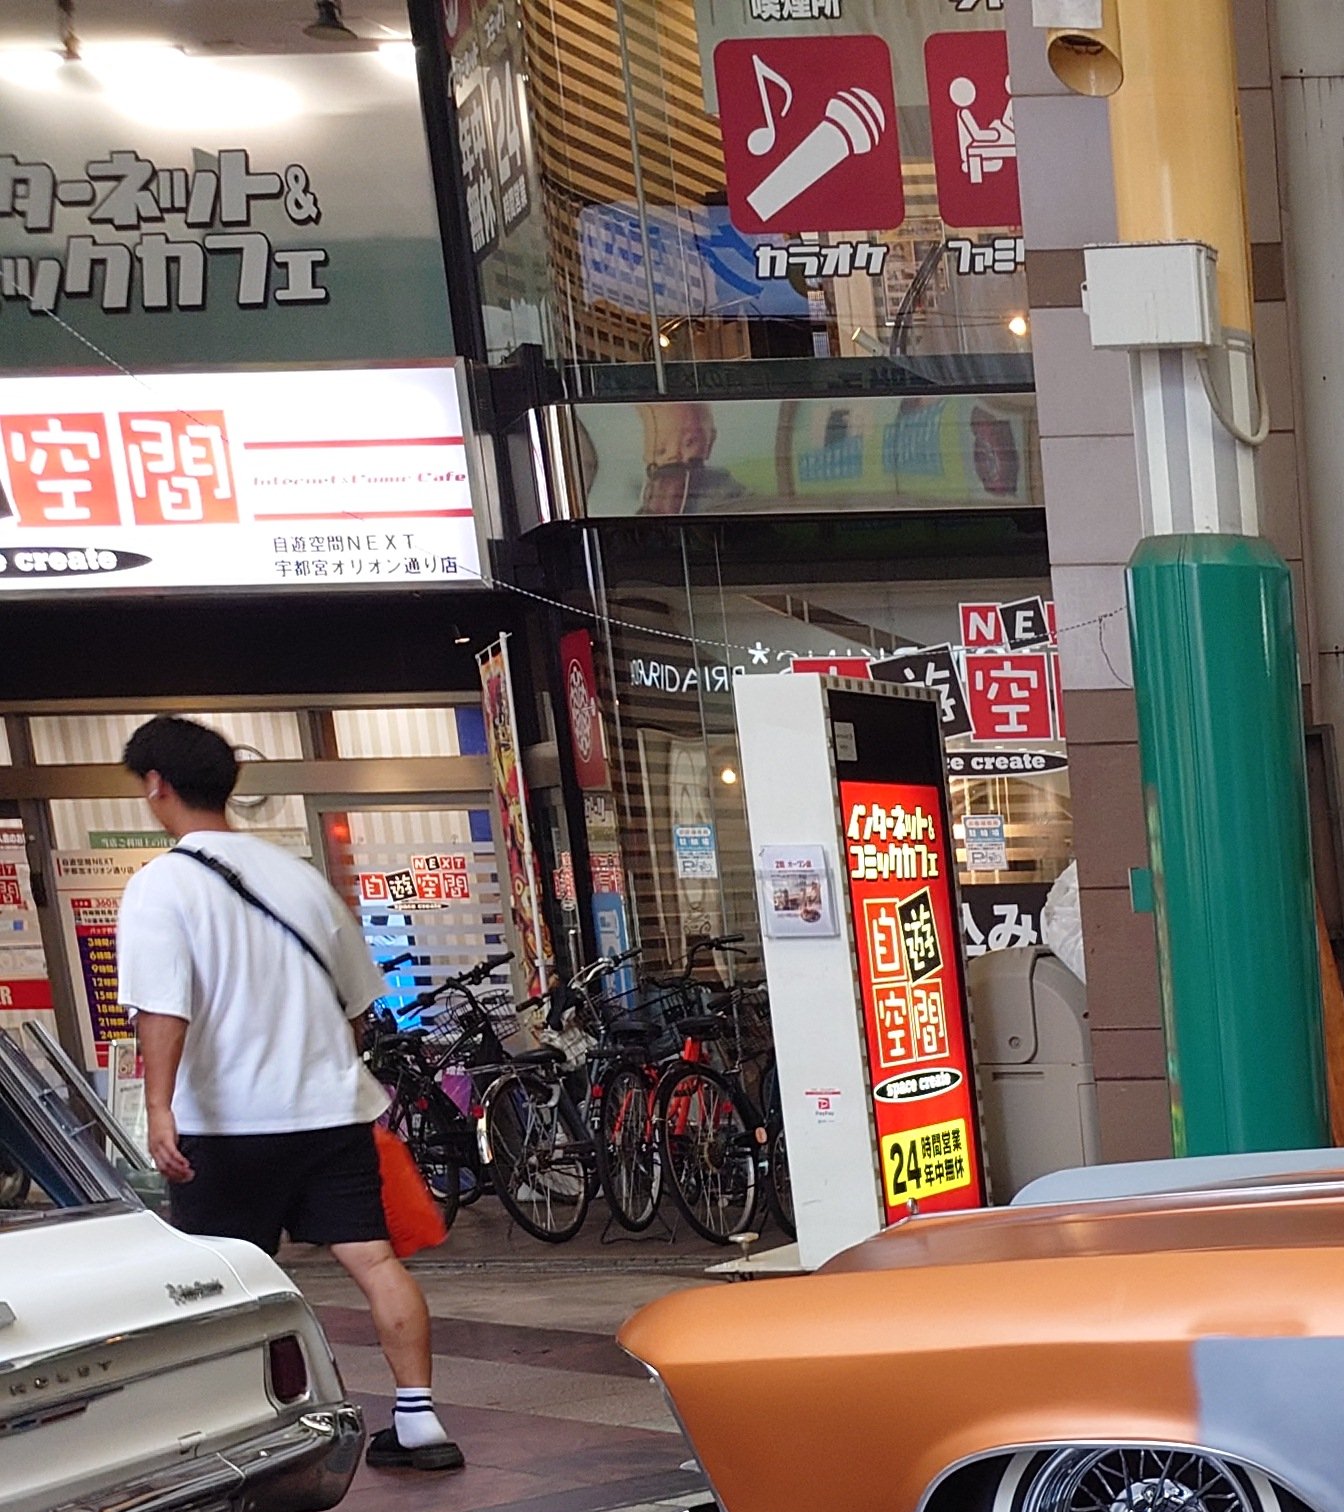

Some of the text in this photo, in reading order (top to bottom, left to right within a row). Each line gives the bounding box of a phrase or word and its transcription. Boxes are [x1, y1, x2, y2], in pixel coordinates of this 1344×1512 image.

[756, 242, 889, 279] カラオケ
[15, 546, 119, 573] create
[274, 555, 459, 578] 宇都宮オリオン通り店
[969, 609, 1057, 641] NE
[972, 752, 1047, 773] create
[413, 858, 464, 870] NEXT
[849, 843, 939, 880] コミックカフェ
[365, 873, 468, 898] 自遊空間
[920, 1128, 962, 1159] 時間営業
[890, 1139, 922, 1195] 24
[923, 1155, 965, 1187] 年中無休
